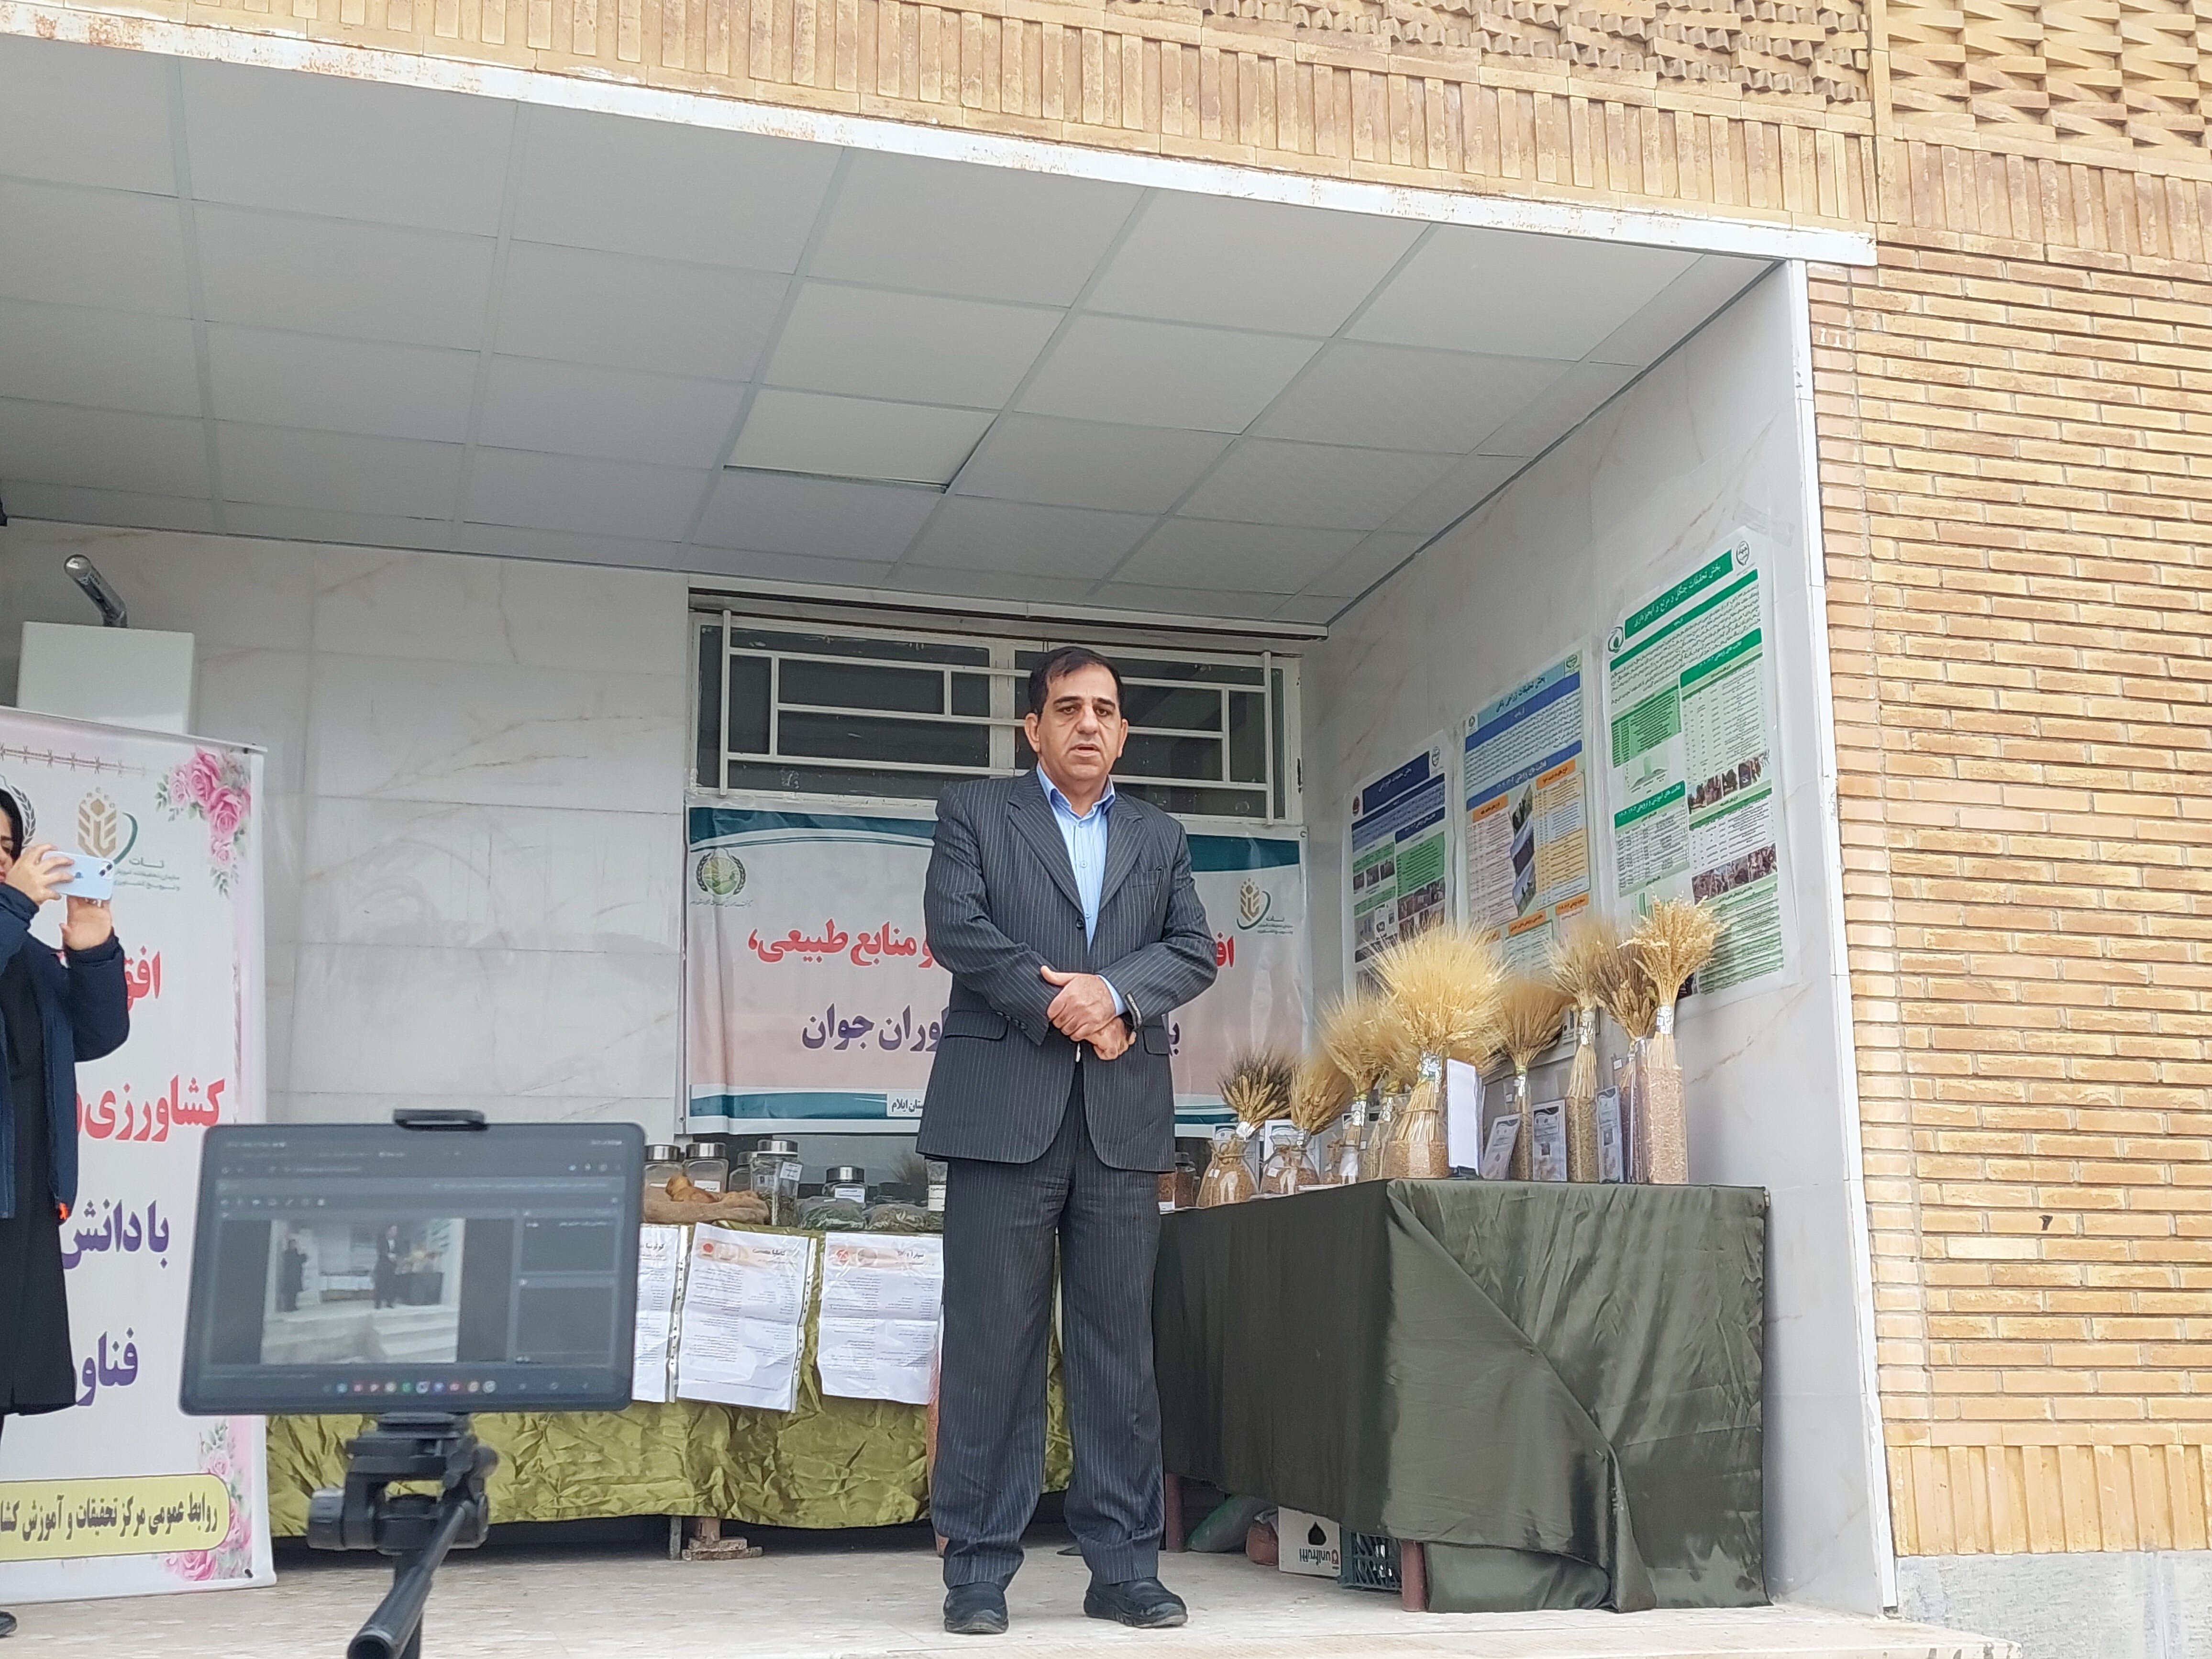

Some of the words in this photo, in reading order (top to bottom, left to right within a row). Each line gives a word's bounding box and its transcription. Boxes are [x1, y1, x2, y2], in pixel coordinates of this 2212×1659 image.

[748, 918, 849, 963] طبیعی،
[851, 921, 918, 966] منابع
[1217, 932, 1235, 968] اف
[802, 1003, 875, 1051] جوان
[1168, 1022, 1180, 1055] ب
[85, 1074, 225, 1142] کشاورزی
[891, 1098, 908, 1113] ایلام
[908, 1098, 923, 1113] تان
[62, 1198, 142, 1270] دانش
[77, 1327, 139, 1406] فناو
[0, 1500, 21, 1532] کشا
[22, 1494, 65, 1541] آموزش
[66, 1512, 73, 1540] و
[76, 1496, 118, 1536] تحقیقات
[119, 1495, 145, 1537] مرکز
[148, 1501, 184, 1535] عمومی
[187, 1491, 218, 1533] روابط
